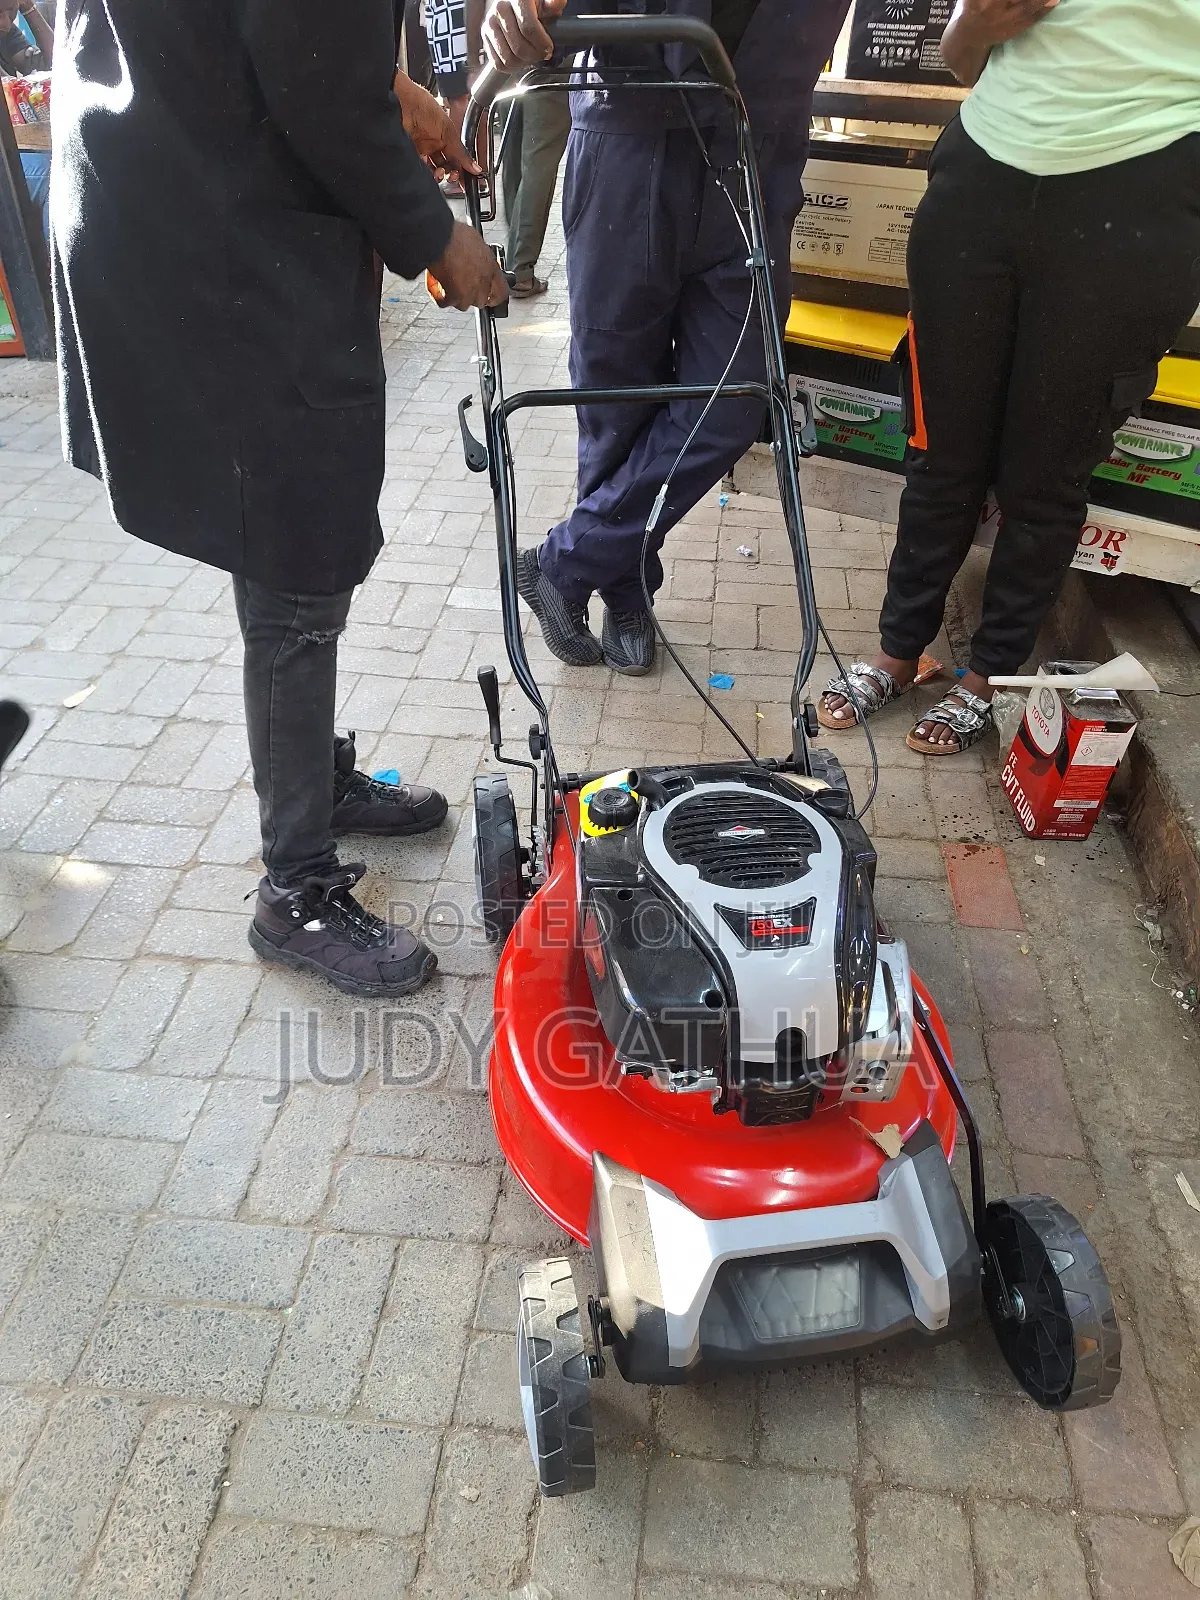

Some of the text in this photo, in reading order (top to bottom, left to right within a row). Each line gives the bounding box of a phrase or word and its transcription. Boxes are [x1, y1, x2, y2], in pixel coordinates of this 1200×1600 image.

[808, 383, 825, 391] SEALED
[825, 386, 856, 398] MAINTENANCE
[867, 396, 883, 404] SOLAR
[819, 396, 876, 418] POWERMATE
[832, 433, 852, 444] MF
[837, 423, 876, 441] Battery
[1161, 429, 1175, 437] FREE
[1176, 432, 1195, 441] SOLAR
[1114, 432, 1185, 456] POWERMATE
[1126, 471, 1151, 484] MF
[1135, 462, 1183, 481] Battery
[1031, 705, 1050, 738] TOYOTA
[1008, 751, 1018, 769] FE
[1001, 764, 1036, 832] CVT FLUID
[747, 917, 794, 930] 750EX
